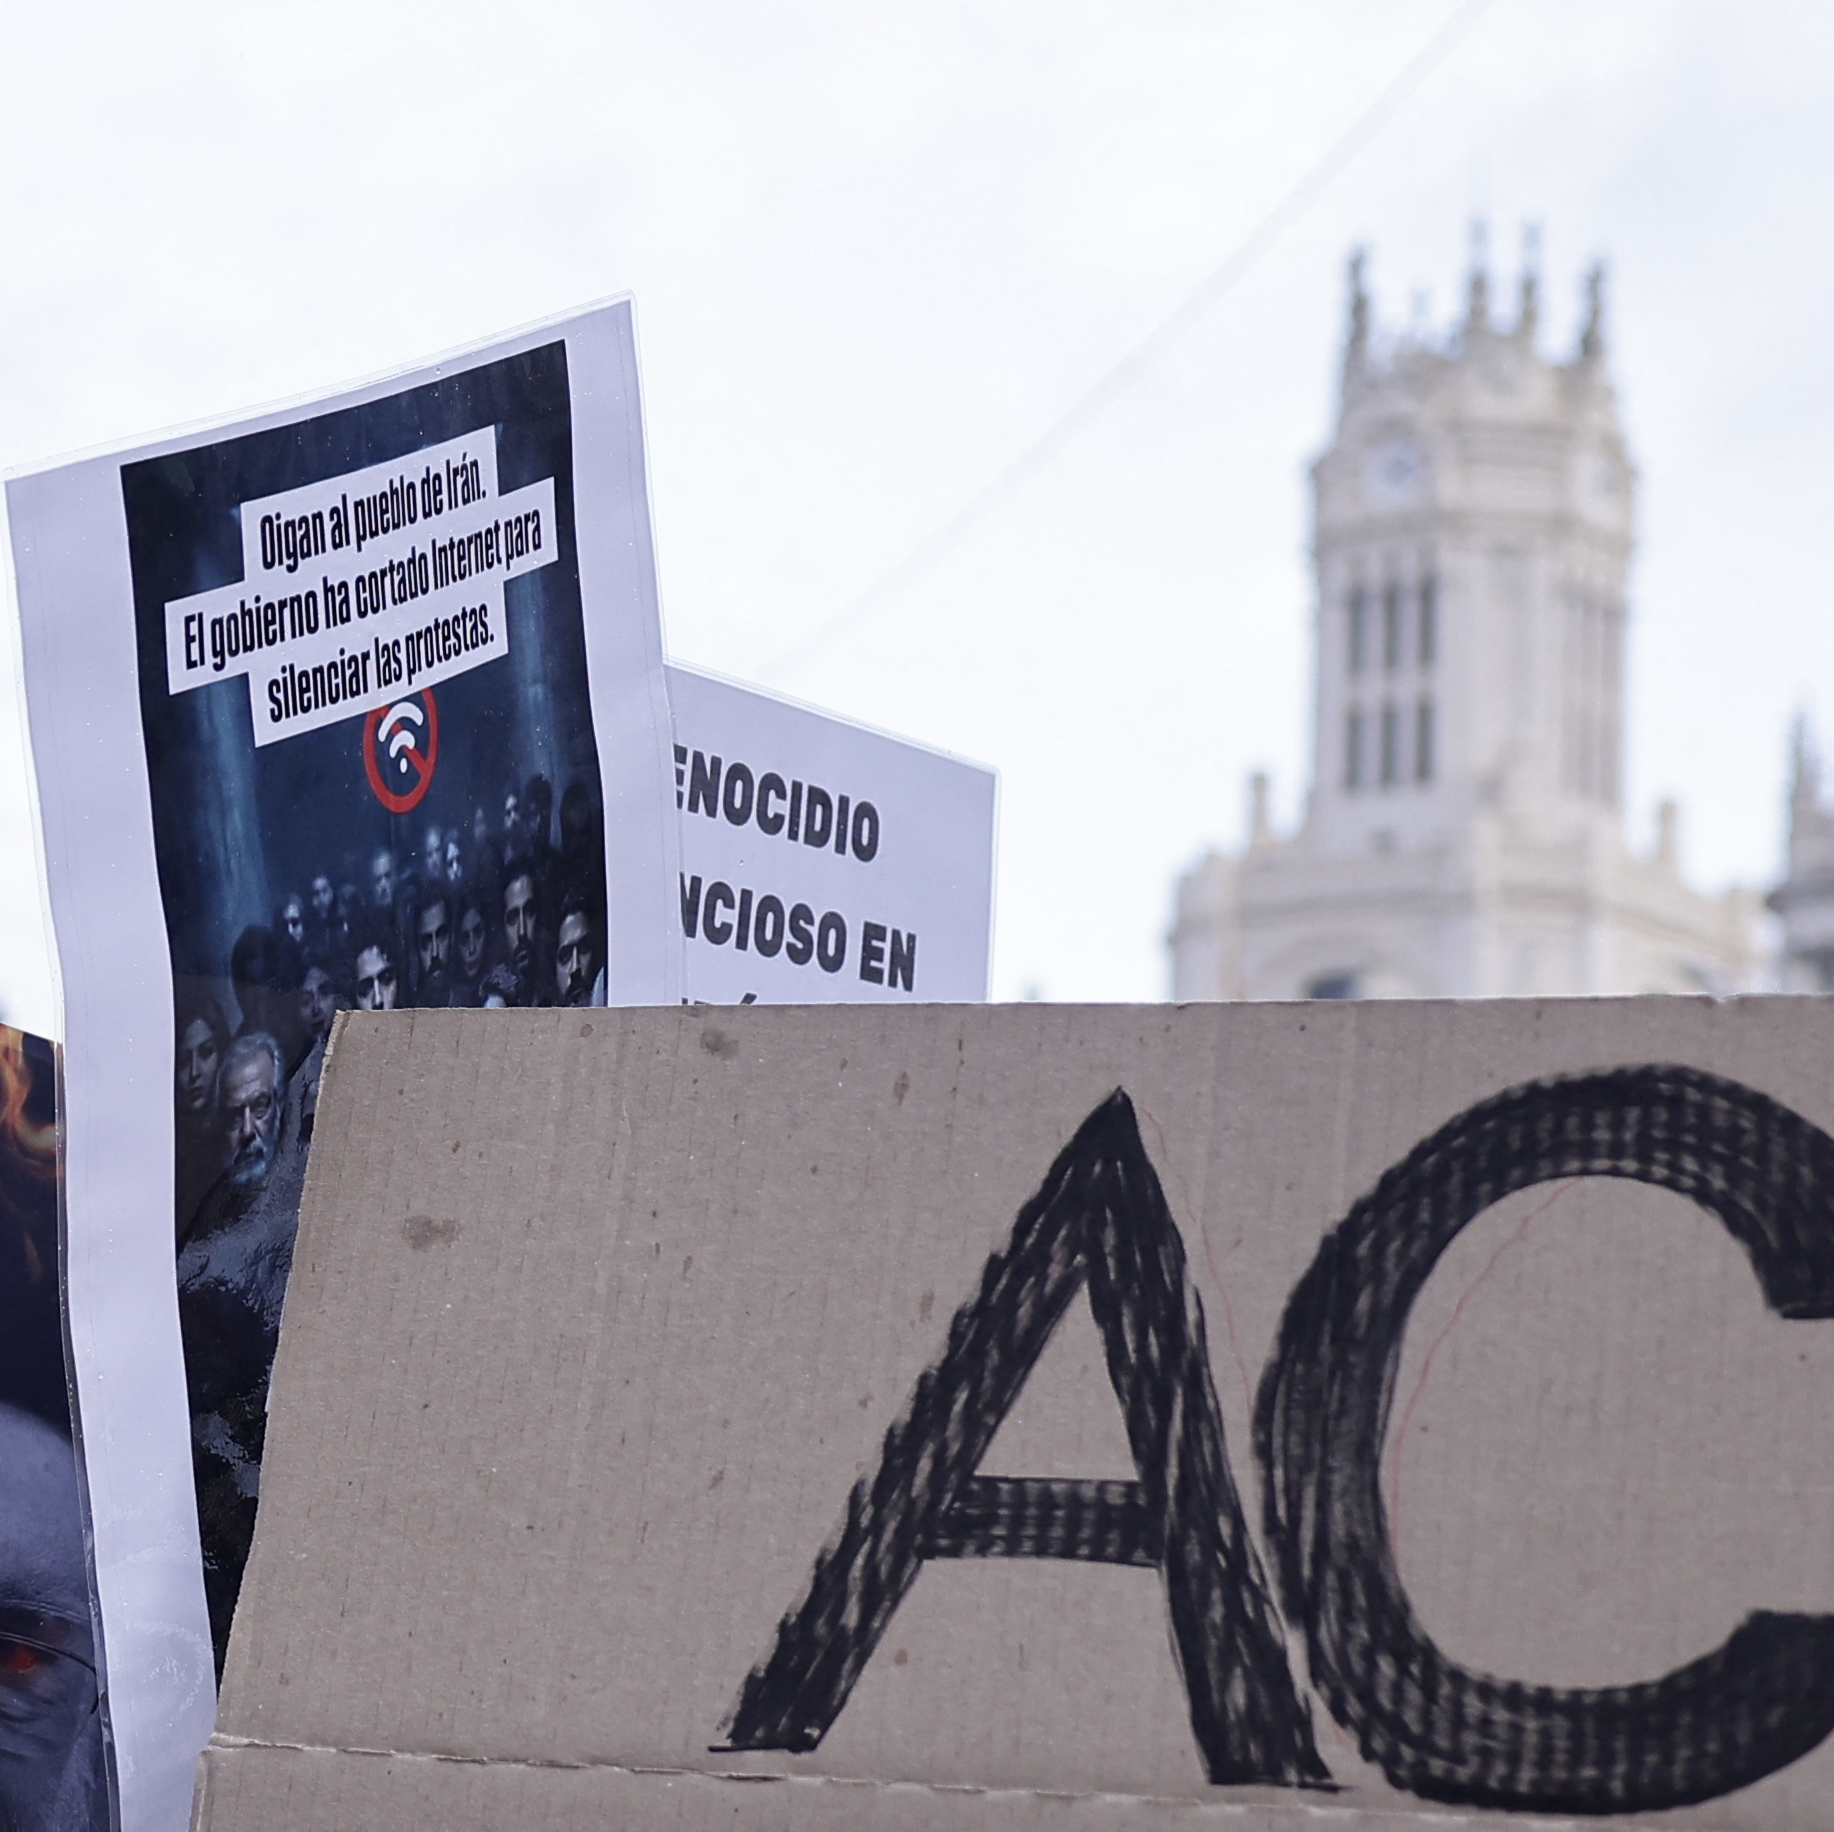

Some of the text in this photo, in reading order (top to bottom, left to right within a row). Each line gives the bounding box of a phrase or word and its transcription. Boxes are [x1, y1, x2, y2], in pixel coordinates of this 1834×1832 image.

[259, 452, 487, 574] Oigan al pueblo de Irán.
[183, 508, 543, 672] El gobierno ha cortado Internet para
[267, 602, 495, 724] silenciar las protestas.
[859, 920, 917, 993] EN
